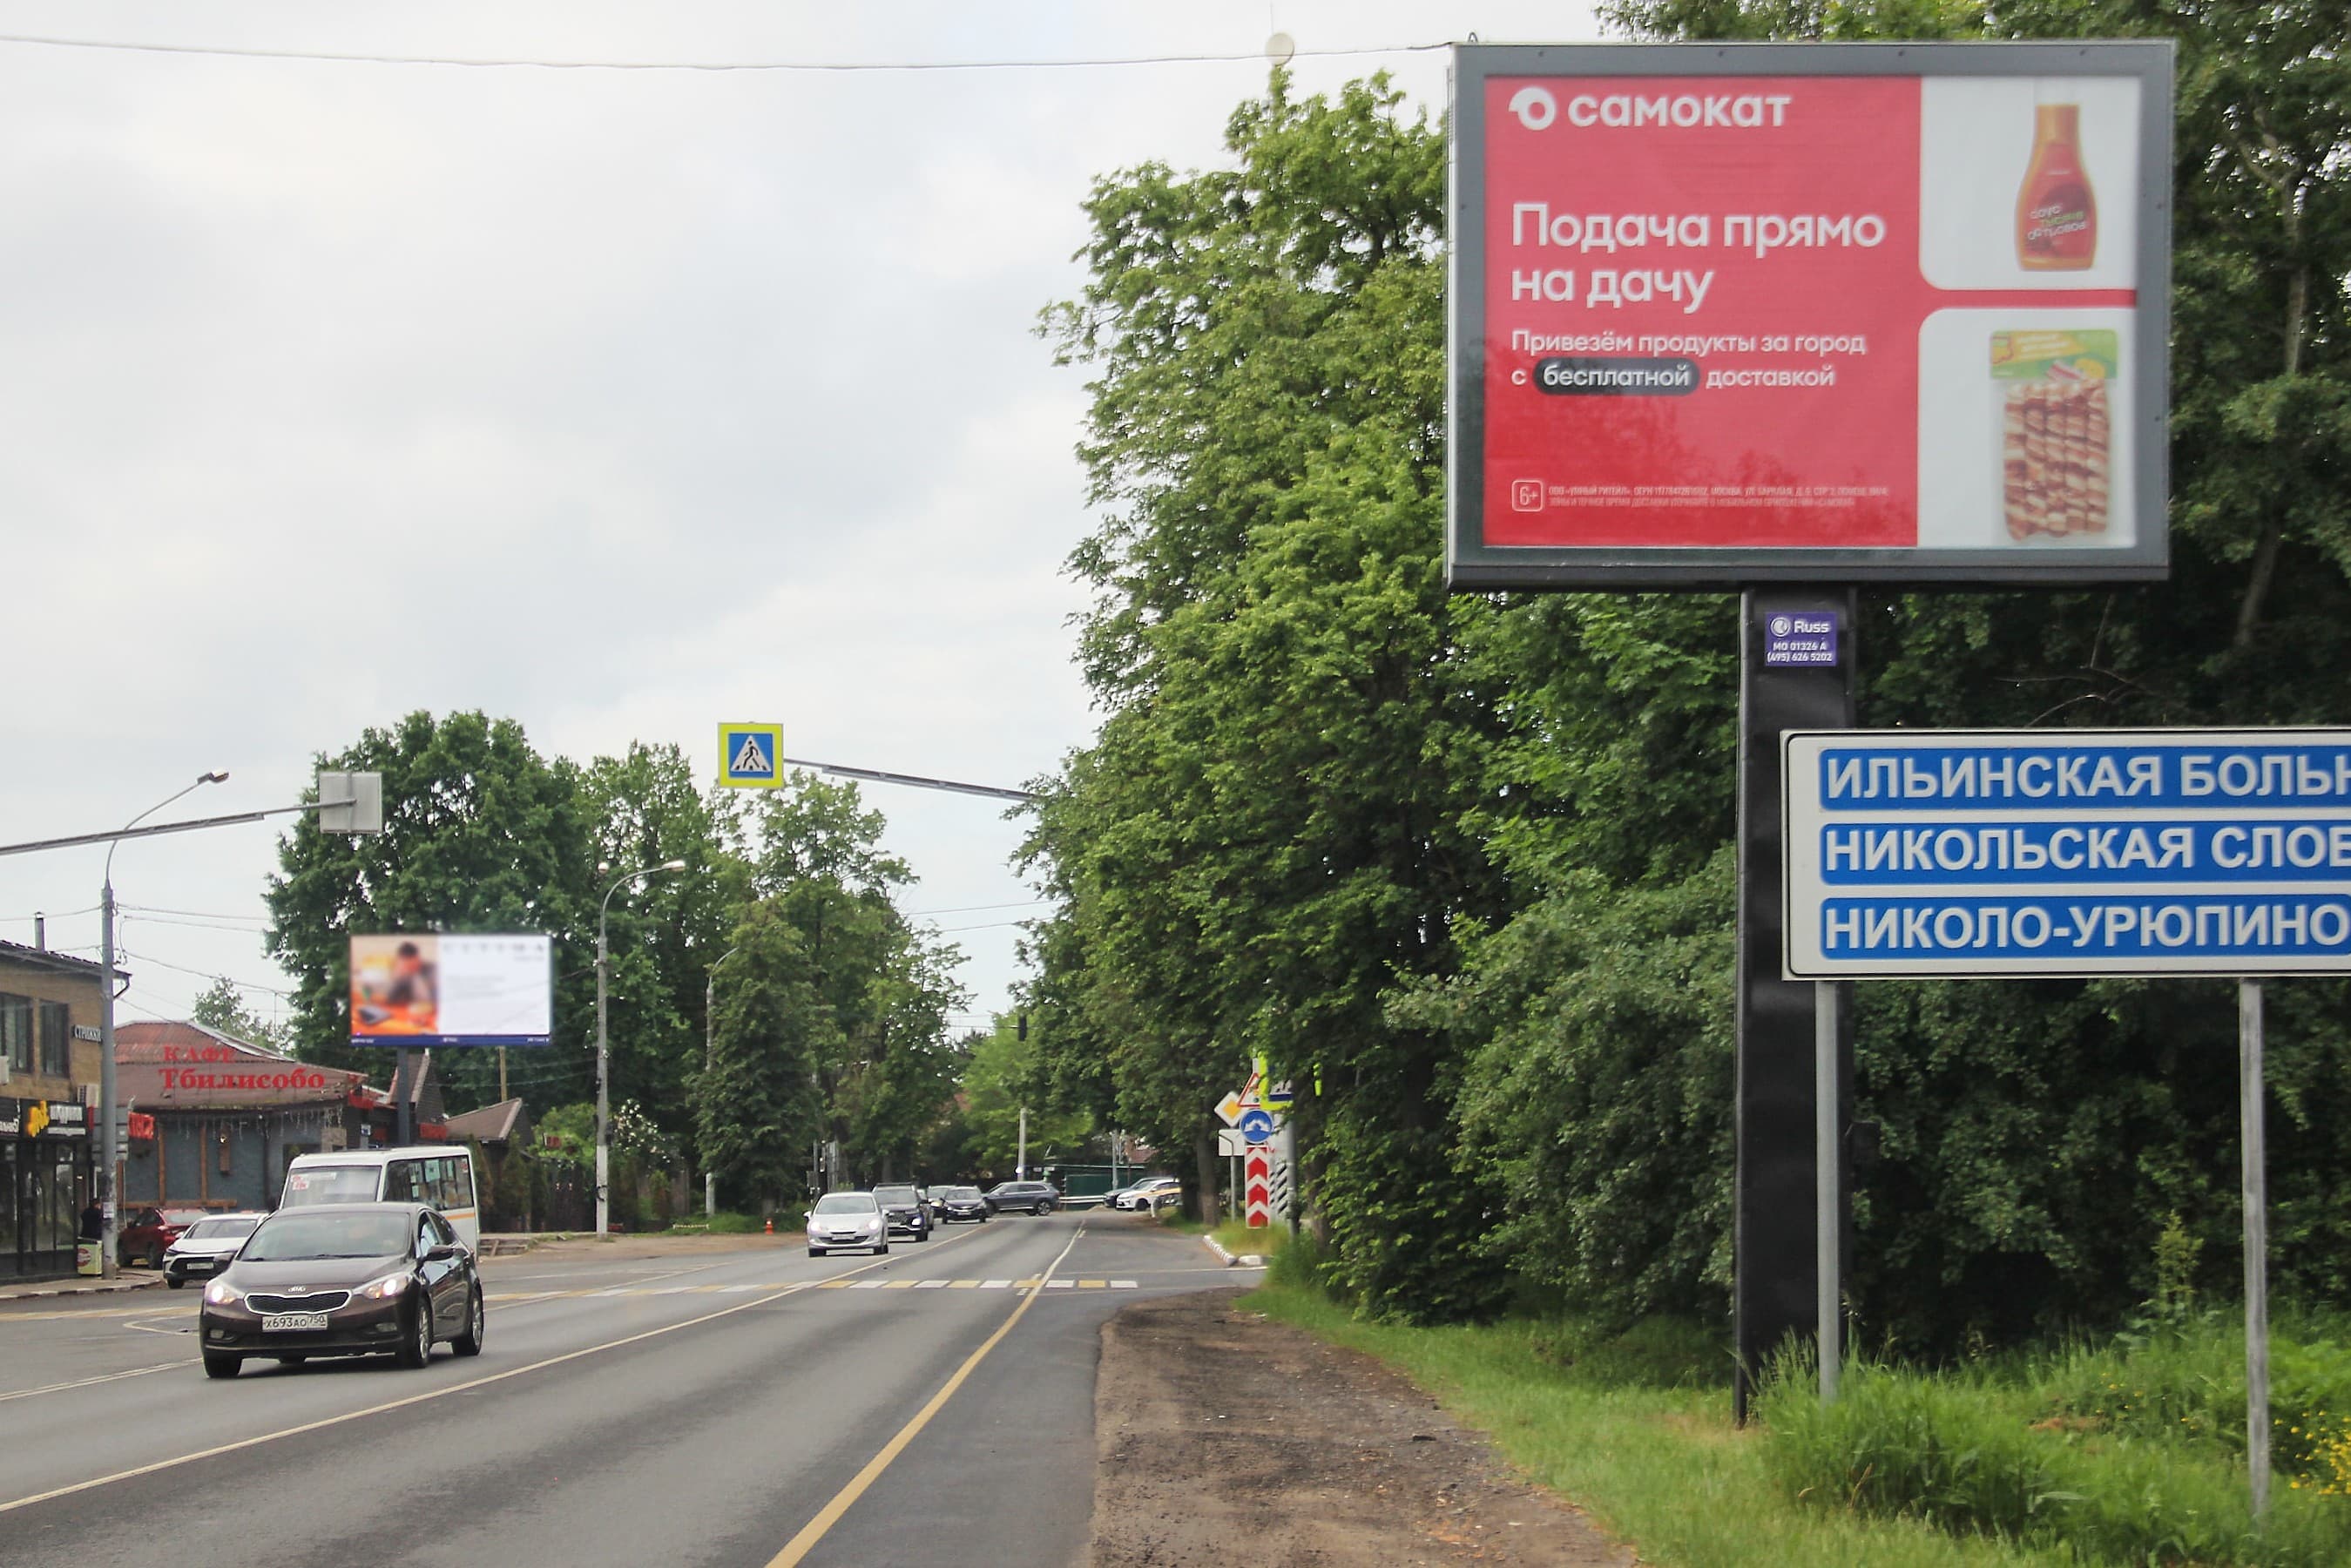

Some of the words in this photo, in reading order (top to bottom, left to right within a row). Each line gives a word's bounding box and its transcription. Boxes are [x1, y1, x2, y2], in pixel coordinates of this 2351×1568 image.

[1568, 95, 1791, 127] самокат
[1512, 203, 1709, 253] Подача
[1724, 214, 1886, 259] прямо
[1511, 268, 1575, 301] на
[1586, 268, 1714, 314] дачу
[1511, 328, 1632, 355] Привезём
[1638, 334, 1757, 357] продукты
[1761, 335, 1789, 352] за
[1794, 334, 1866, 356] город
[1511, 368, 1527, 386] с
[1543, 363, 1690, 387] бесплатной
[1706, 365, 1834, 389] доставкой
[1518, 485, 1538, 506] 6+
[1794, 620, 1830, 633] Russ
[1767, 652, 1790, 662] (495)
[1791, 652, 1808, 662] 626
[1810, 652, 1833, 662] 5202
[1790, 641, 1818, 652] 01326
[1827, 755, 2161, 799] ИЛЬИНСКАЯ
[1826, 827, 2193, 871] НИКОЛЬСКАЯ
[1826, 903, 2350, 949] НИКОЛО-УРЮПИНО
[163, 1044, 235, 1064] КАФЕ
[159, 1067, 325, 1090] Тбилисобо
